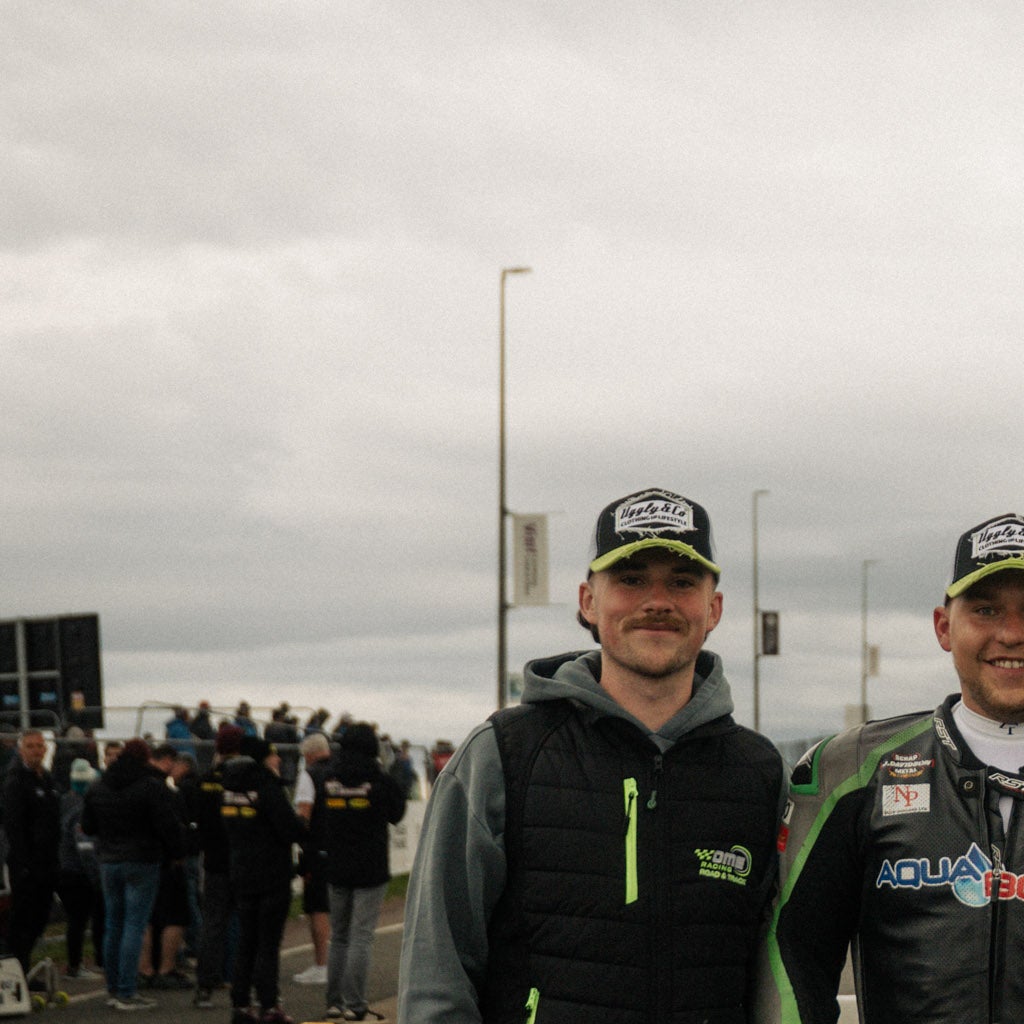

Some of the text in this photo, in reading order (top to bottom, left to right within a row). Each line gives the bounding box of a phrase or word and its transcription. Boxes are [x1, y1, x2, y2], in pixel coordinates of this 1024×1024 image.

[658, 514, 687, 526] LIFESTYLE
[934, 717, 958, 751] RST
[700, 861, 733, 873] RACING
[876, 856, 984, 889] AQUA
